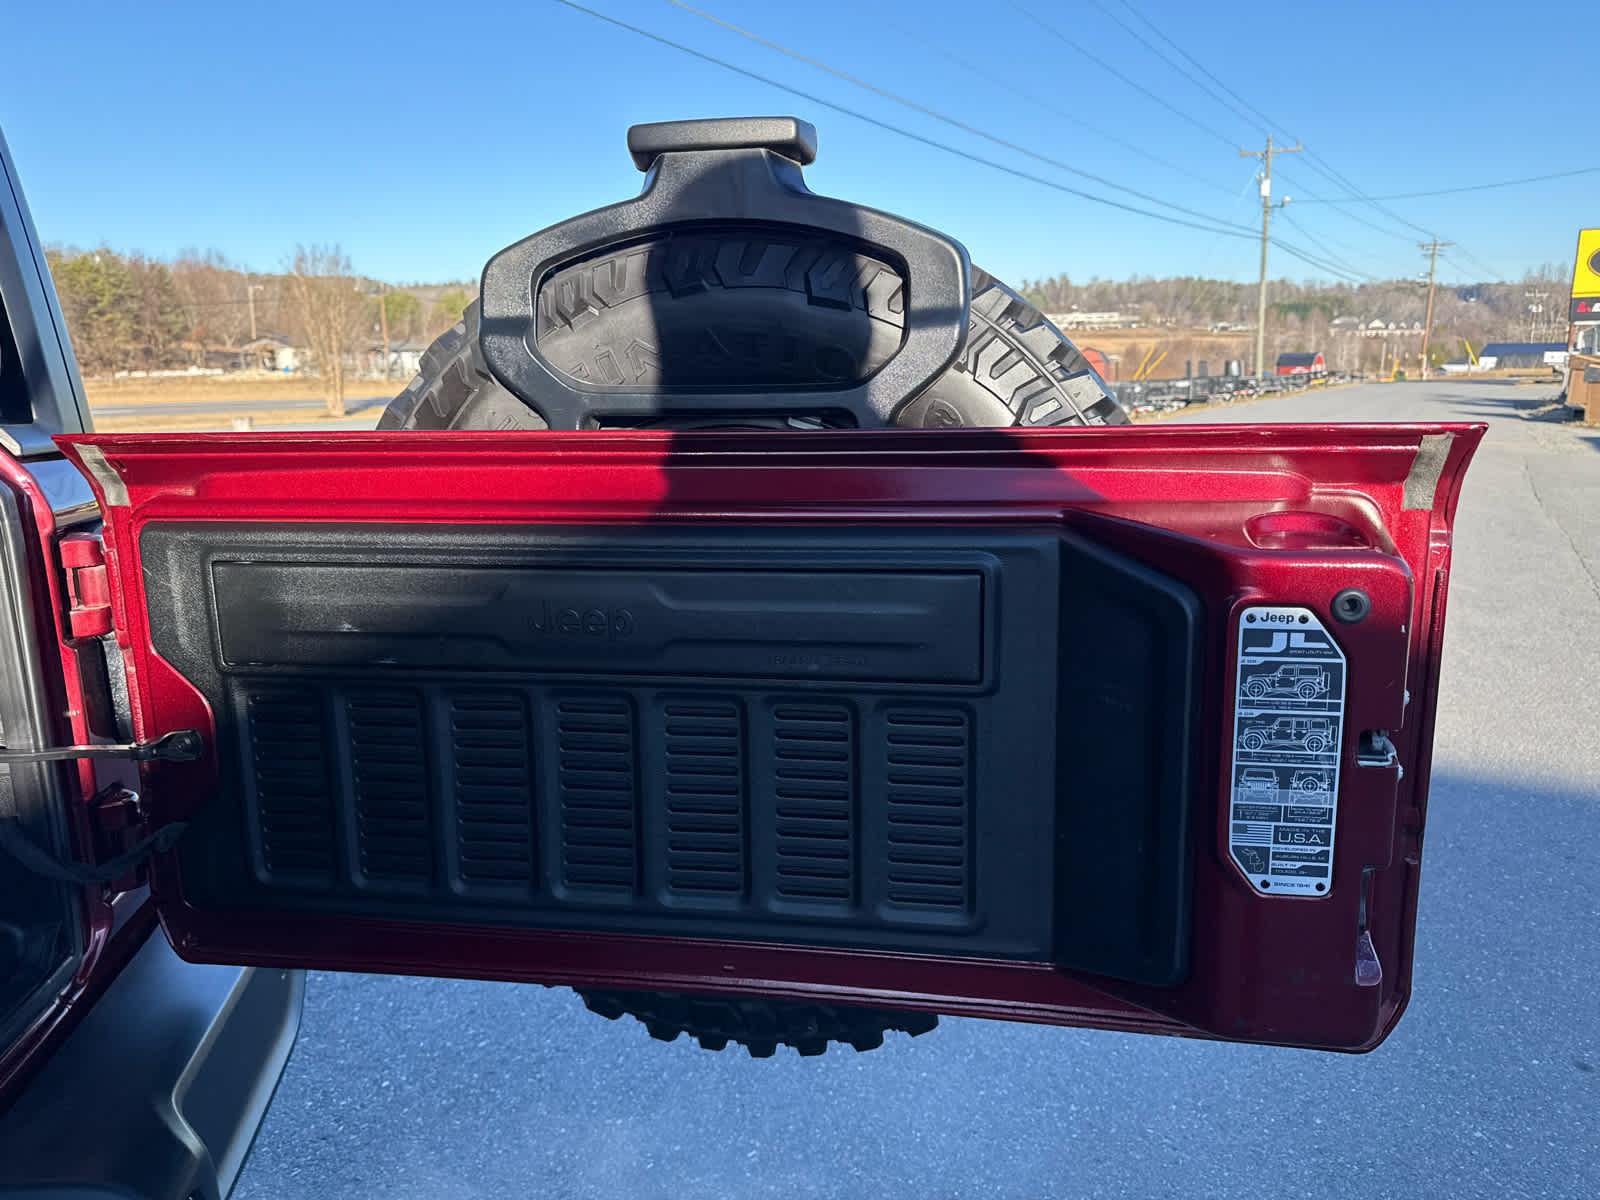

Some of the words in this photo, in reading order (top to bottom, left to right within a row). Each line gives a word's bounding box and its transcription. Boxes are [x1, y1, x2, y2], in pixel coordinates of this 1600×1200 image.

[527, 600, 634, 641] Jeep
[1261, 612, 1295, 624] Jeep
[1244, 631, 1330, 652] JL
[1279, 831, 1325, 845] U.S.A.
